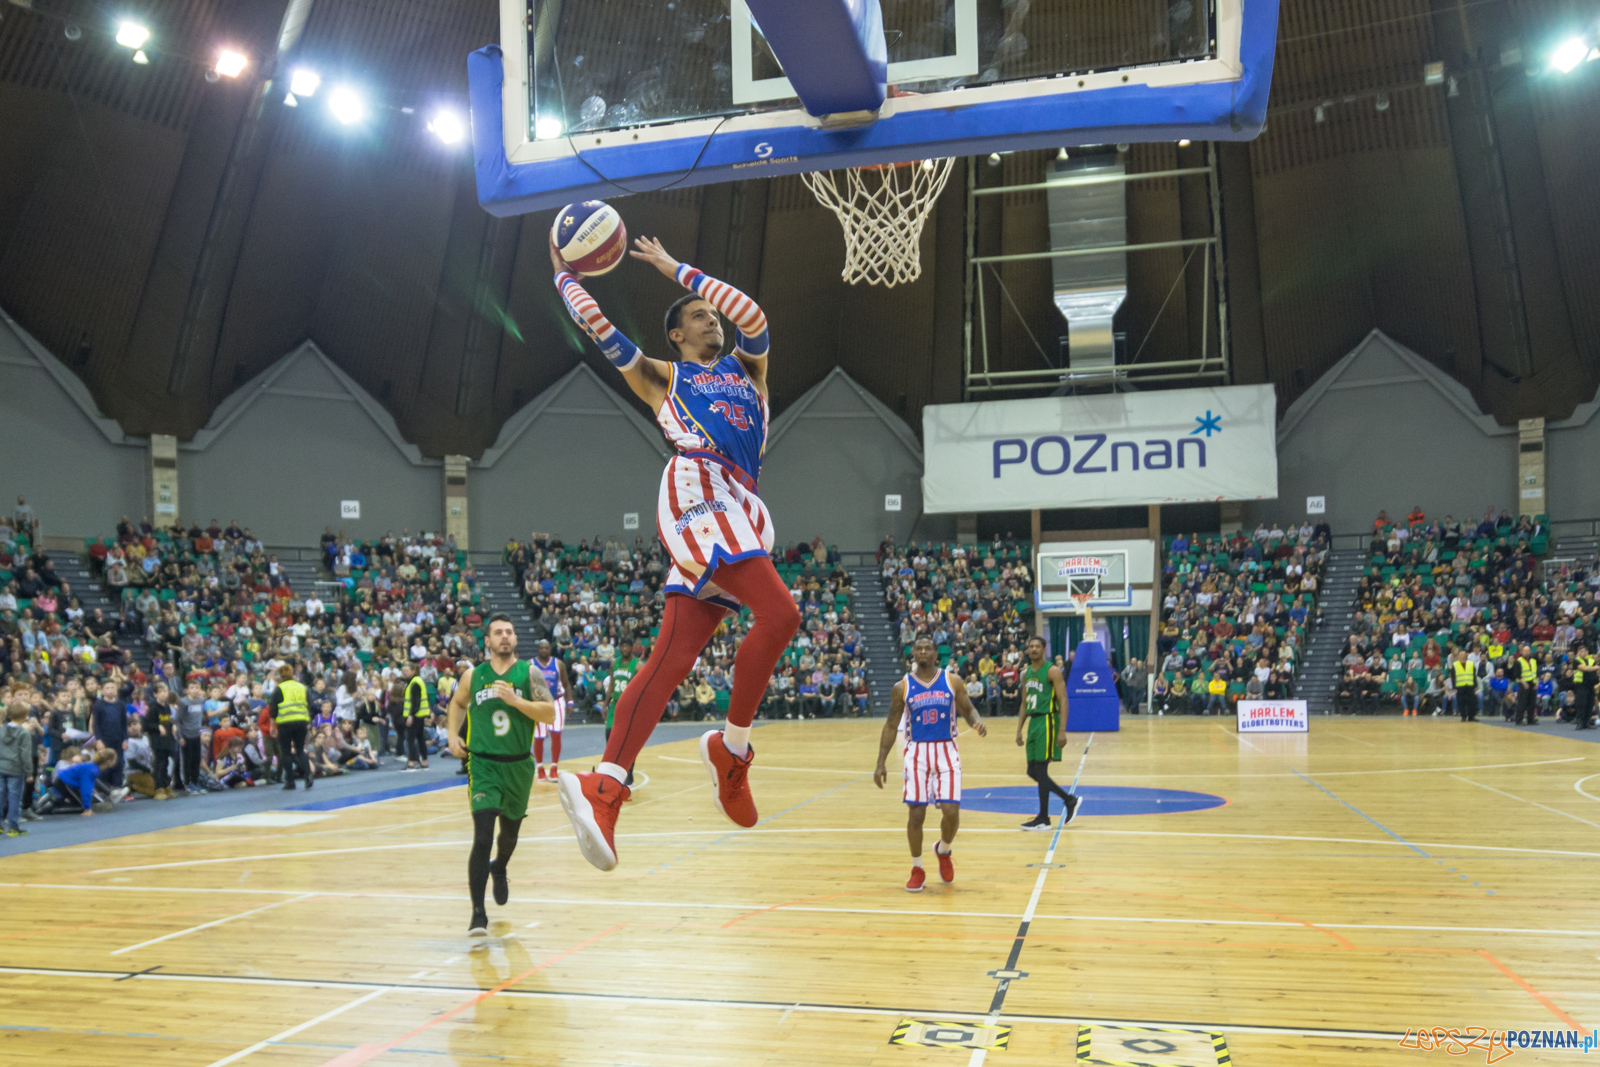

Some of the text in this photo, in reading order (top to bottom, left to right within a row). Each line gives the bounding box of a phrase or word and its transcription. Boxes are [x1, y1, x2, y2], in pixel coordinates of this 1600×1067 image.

[714, 400, 749, 431] 25
[343, 504, 357, 513] B4
[674, 500, 728, 536] GLOBETROTTERS
[1065, 557, 1101, 567] HARLEM
[1058, 567, 1108, 576] GLOBETROTTERS
[614, 680, 628, 693] 26
[914, 690, 945, 702] HARLEM
[922, 709, 938, 724] 19
[1250, 707, 1295, 718] HARLEM
[492, 710, 511, 736] 9
[1241, 719, 1305, 728] GLOBETROTTERS
